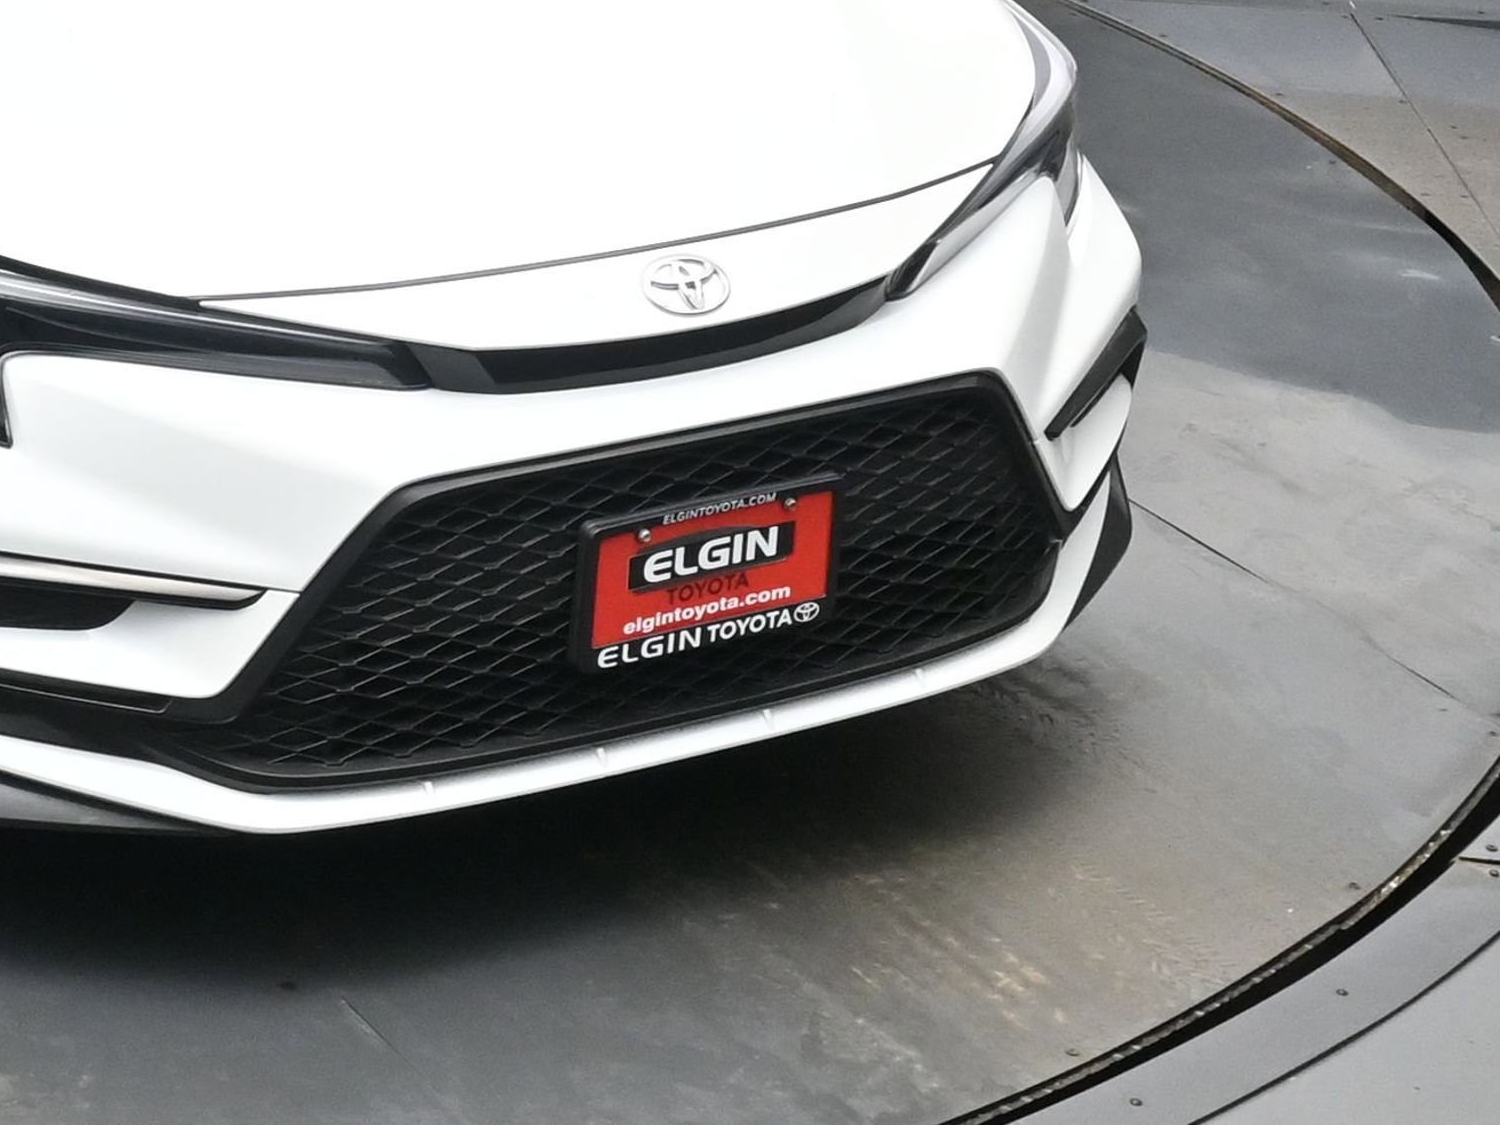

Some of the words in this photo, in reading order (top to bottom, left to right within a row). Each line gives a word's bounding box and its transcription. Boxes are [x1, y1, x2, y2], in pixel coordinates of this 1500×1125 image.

[662, 492, 777, 524] ELGINTOYOTA.COM
[643, 526, 779, 583] ELGIN
[623, 586, 792, 635] elgintoyota.com
[666, 573, 750, 605] TOYOTA
[597, 628, 702, 668] ELGIN
[707, 608, 793, 643] TOYOTA
